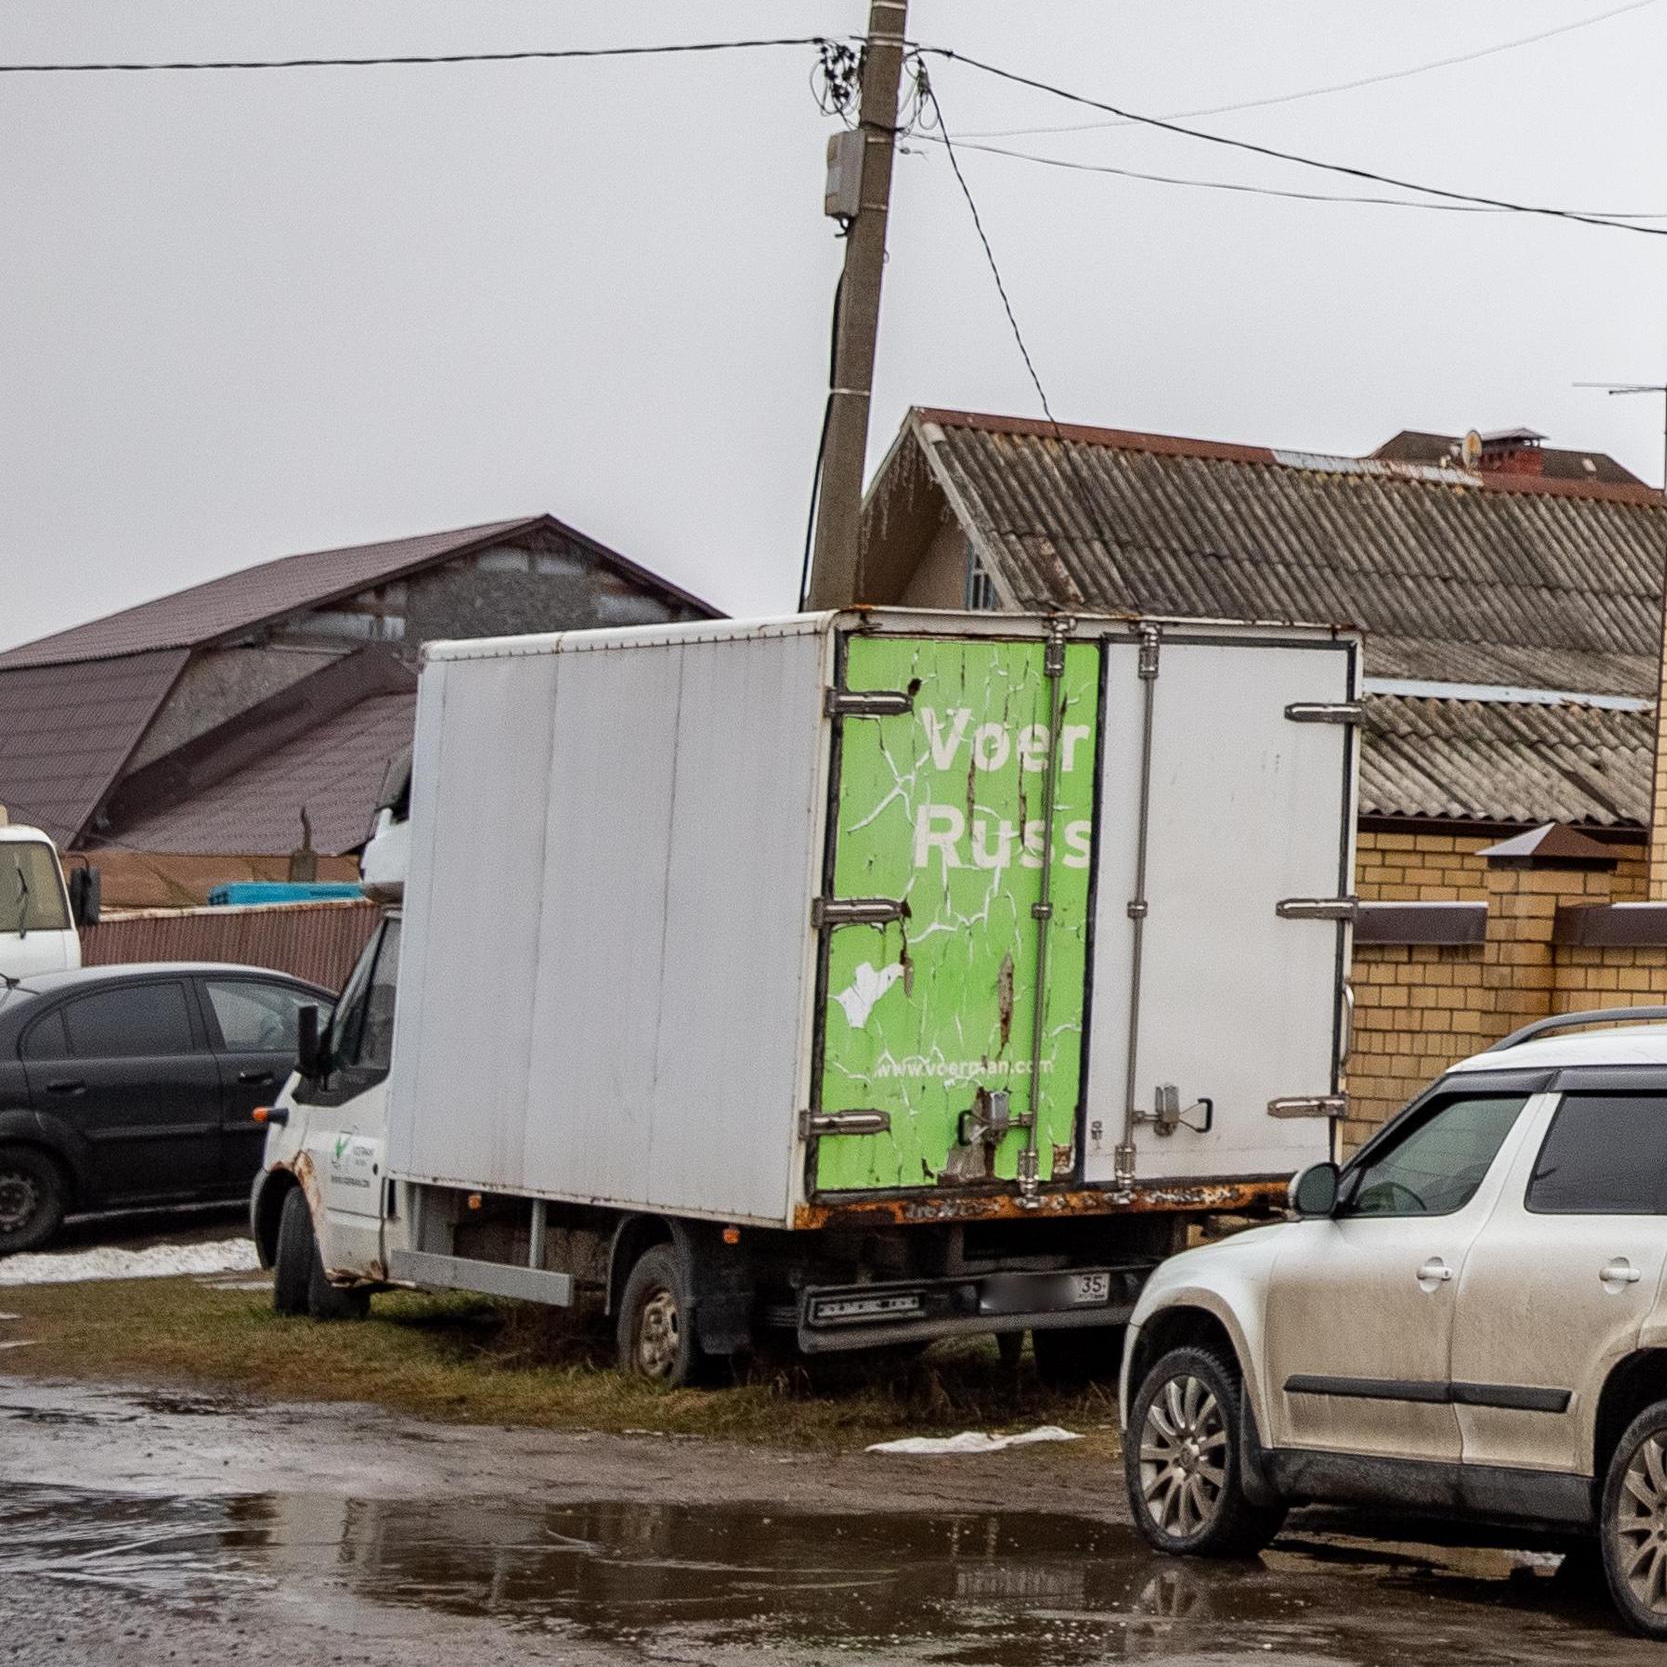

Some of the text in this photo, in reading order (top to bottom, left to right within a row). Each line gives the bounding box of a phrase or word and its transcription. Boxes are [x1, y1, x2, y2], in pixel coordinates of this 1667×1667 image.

[921, 707, 1091, 771] Voer
[914, 804, 1091, 868] Russ
[1081, 1275, 1103, 1293] 35
